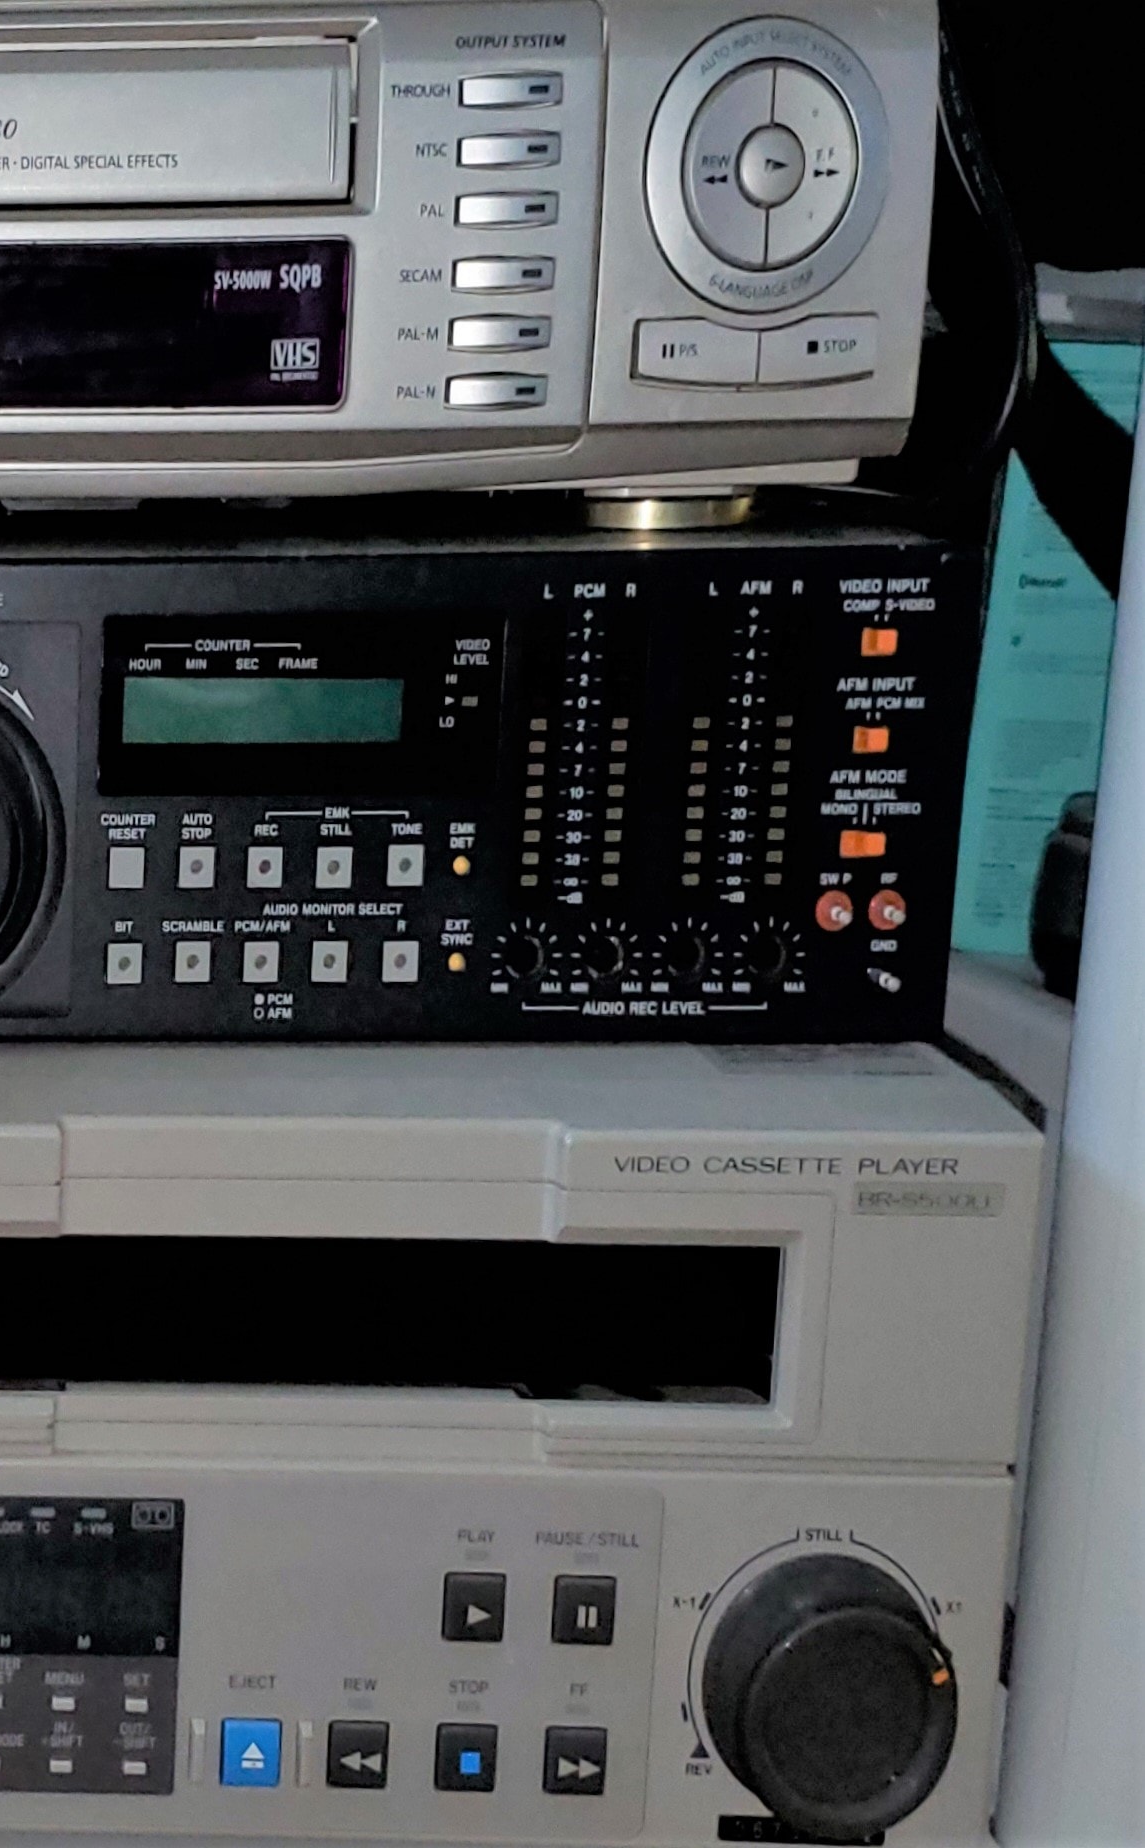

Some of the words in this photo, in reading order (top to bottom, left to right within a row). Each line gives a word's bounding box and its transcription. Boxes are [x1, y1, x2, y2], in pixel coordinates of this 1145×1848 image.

[456, 35, 507, 48] OUTPUT
[513, 35, 566, 48] SYSTEM
[391, 84, 450, 97] THROUGH
[416, 144, 447, 157] NTSC
[20, 156, 70, 169] DIGITAL
[74, 155, 123, 169] SPECIAL
[127, 155, 178, 168] EFFECTS
[420, 204, 443, 217] PAL
[214, 270, 272, 290] SV-5000W
[279, 264, 322, 293] SQPB
[400, 269, 442, 283] SECAM
[398, 327, 439, 340] PAL-M
[823, 340, 856, 352] STOP
[270, 338, 320, 371] VHS
[397, 385, 435, 399] PAL-N
[574, 583, 605, 598] PCM
[741, 581, 771, 595] AFM
[839, 579, 882, 594] VIDEO
[887, 578, 930, 593] INPUT
[843, 599, 880, 612] COMP
[885, 598, 935, 611] S-VIDEO
[195, 640, 251, 651] COUNTER
[455, 639, 490, 651] VIDEO
[129, 658, 161, 671] HOUR
[186, 658, 207, 670] MIN
[236, 657, 259, 670] SEC
[279, 657, 318, 670] FRAME
[453, 653, 489, 665] LEVEL
[837, 678, 868, 692] AFM
[872, 677, 916, 691] INPUT
[439, 716, 454, 727] LO
[830, 770, 860, 784] AFM
[865, 769, 907, 783] MODE
[835, 789, 897, 800] BILINGUAL
[325, 807, 350, 819] EMK
[821, 803, 858, 815] MONO
[873, 802, 921, 815] STEREO
[101, 814, 156, 826] COUNTER
[182, 814, 213, 826] AUTO
[109, 828, 146, 840] RESET
[182, 828, 212, 840] STOP
[254, 824, 279, 836] REC
[320, 824, 352, 836] STILL
[392, 823, 422, 836] TONE
[449, 823, 475, 835] EMK
[450, 837, 474, 849] DET
[263, 903, 298, 916] AUDIO
[302, 903, 354, 916] MONITOR
[358, 903, 403, 915] SELECT
[115, 921, 133, 933] BIT
[162, 920, 224, 932] SCRAMBLE
[235, 920, 290, 933] PCM/AFM
[445, 920, 469, 931] EXT
[441, 933, 473, 946] SYNC
[267, 993, 293, 1005] PCM
[267, 1007, 292, 1019] AFM
[583, 1002, 624, 1016] AUDIO
[629, 1002, 657, 1015] REC
[662, 1001, 705, 1015] LEVEL
[615, 1156, 690, 1173] VIDEO
[704, 1157, 842, 1175] CASSETTE
[858, 1158, 958, 1175] PLAYER
[458, 1530, 494, 1543] PLAY
[536, 1532, 639, 1548] PAUSE/STILL
[805, 1529, 842, 1541] STILL
[45, 1672, 84, 1685] MENU
[229, 1676, 276, 1689] EJECT
[344, 1678, 377, 1691] REW
[449, 1681, 488, 1694] STOP
[686, 1764, 712, 1775] REV
